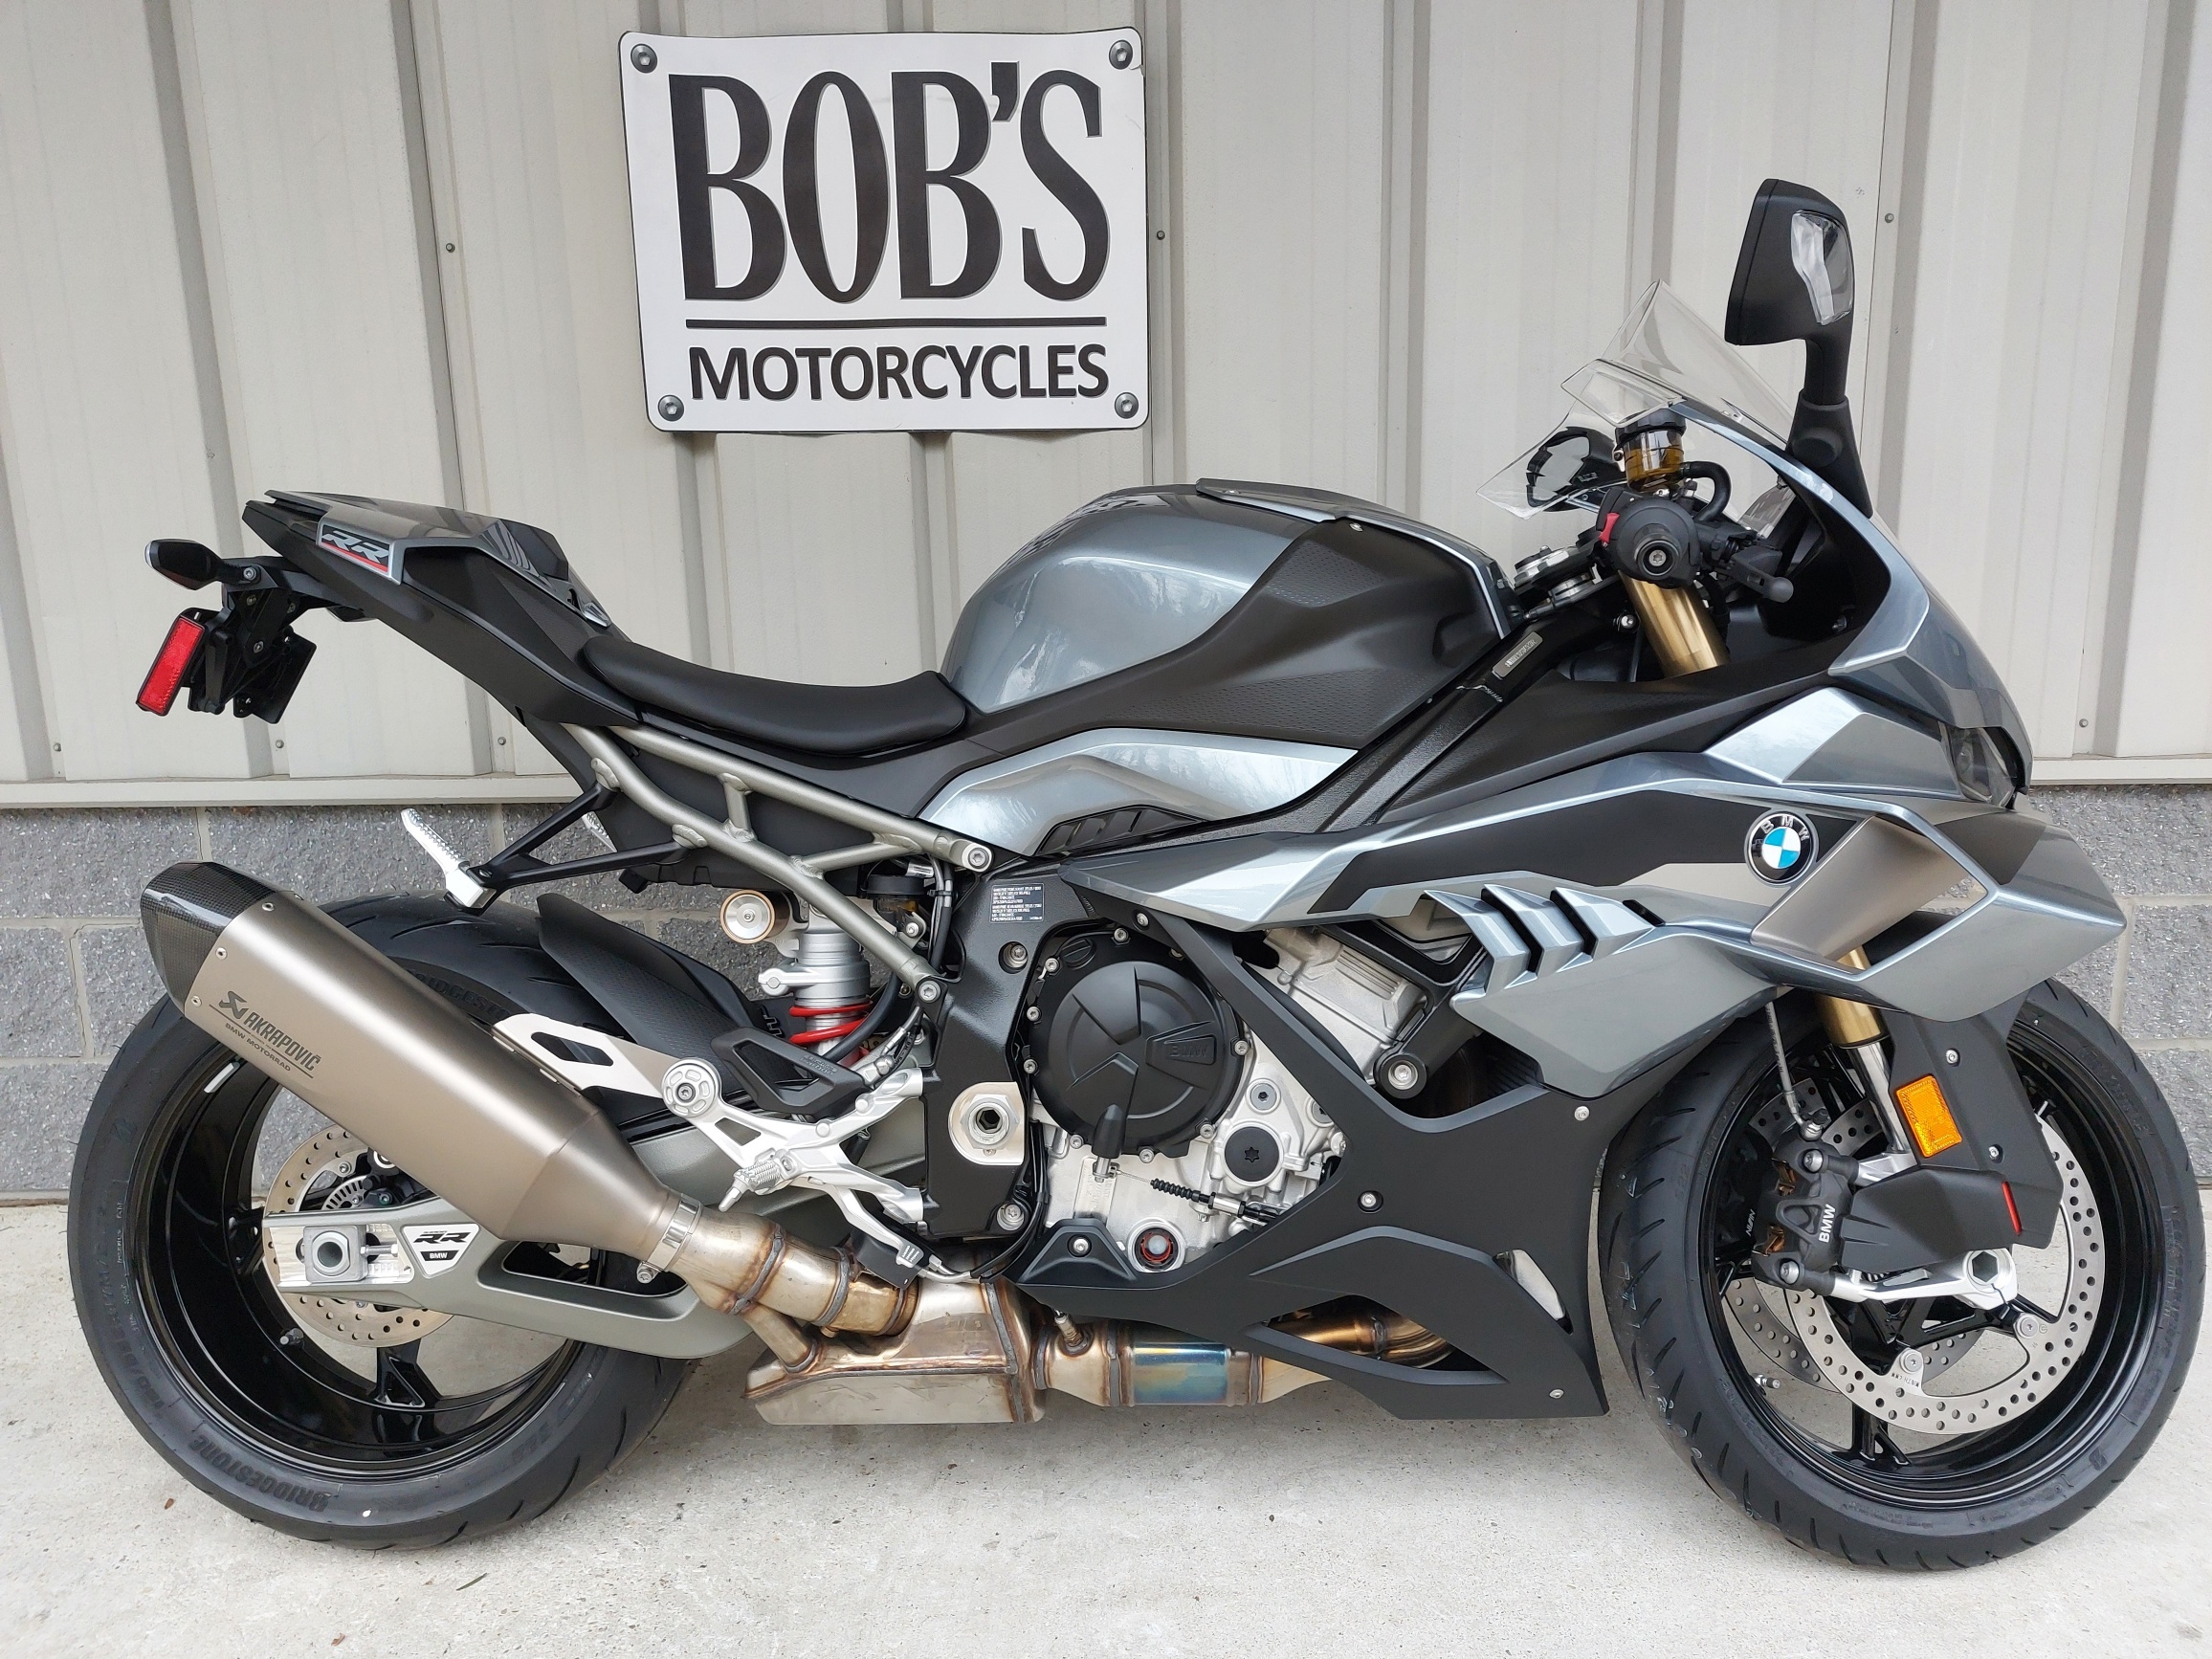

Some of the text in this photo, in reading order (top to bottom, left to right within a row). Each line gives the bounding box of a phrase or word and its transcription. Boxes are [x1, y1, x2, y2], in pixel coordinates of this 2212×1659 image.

[668, 61, 1111, 303] BOB'S
[688, 343, 1109, 402] MOTORCYCLES
[321, 530, 389, 564] RR
[1760, 815, 1810, 841] BMW
[224, 1021, 246, 1043] BMW
[244, 1036, 291, 1072] MOTORRAD
[1170, 1045, 1207, 1058] BMW
[413, 1232, 471, 1244] RR
[1819, 1204, 1835, 1243] BMW
